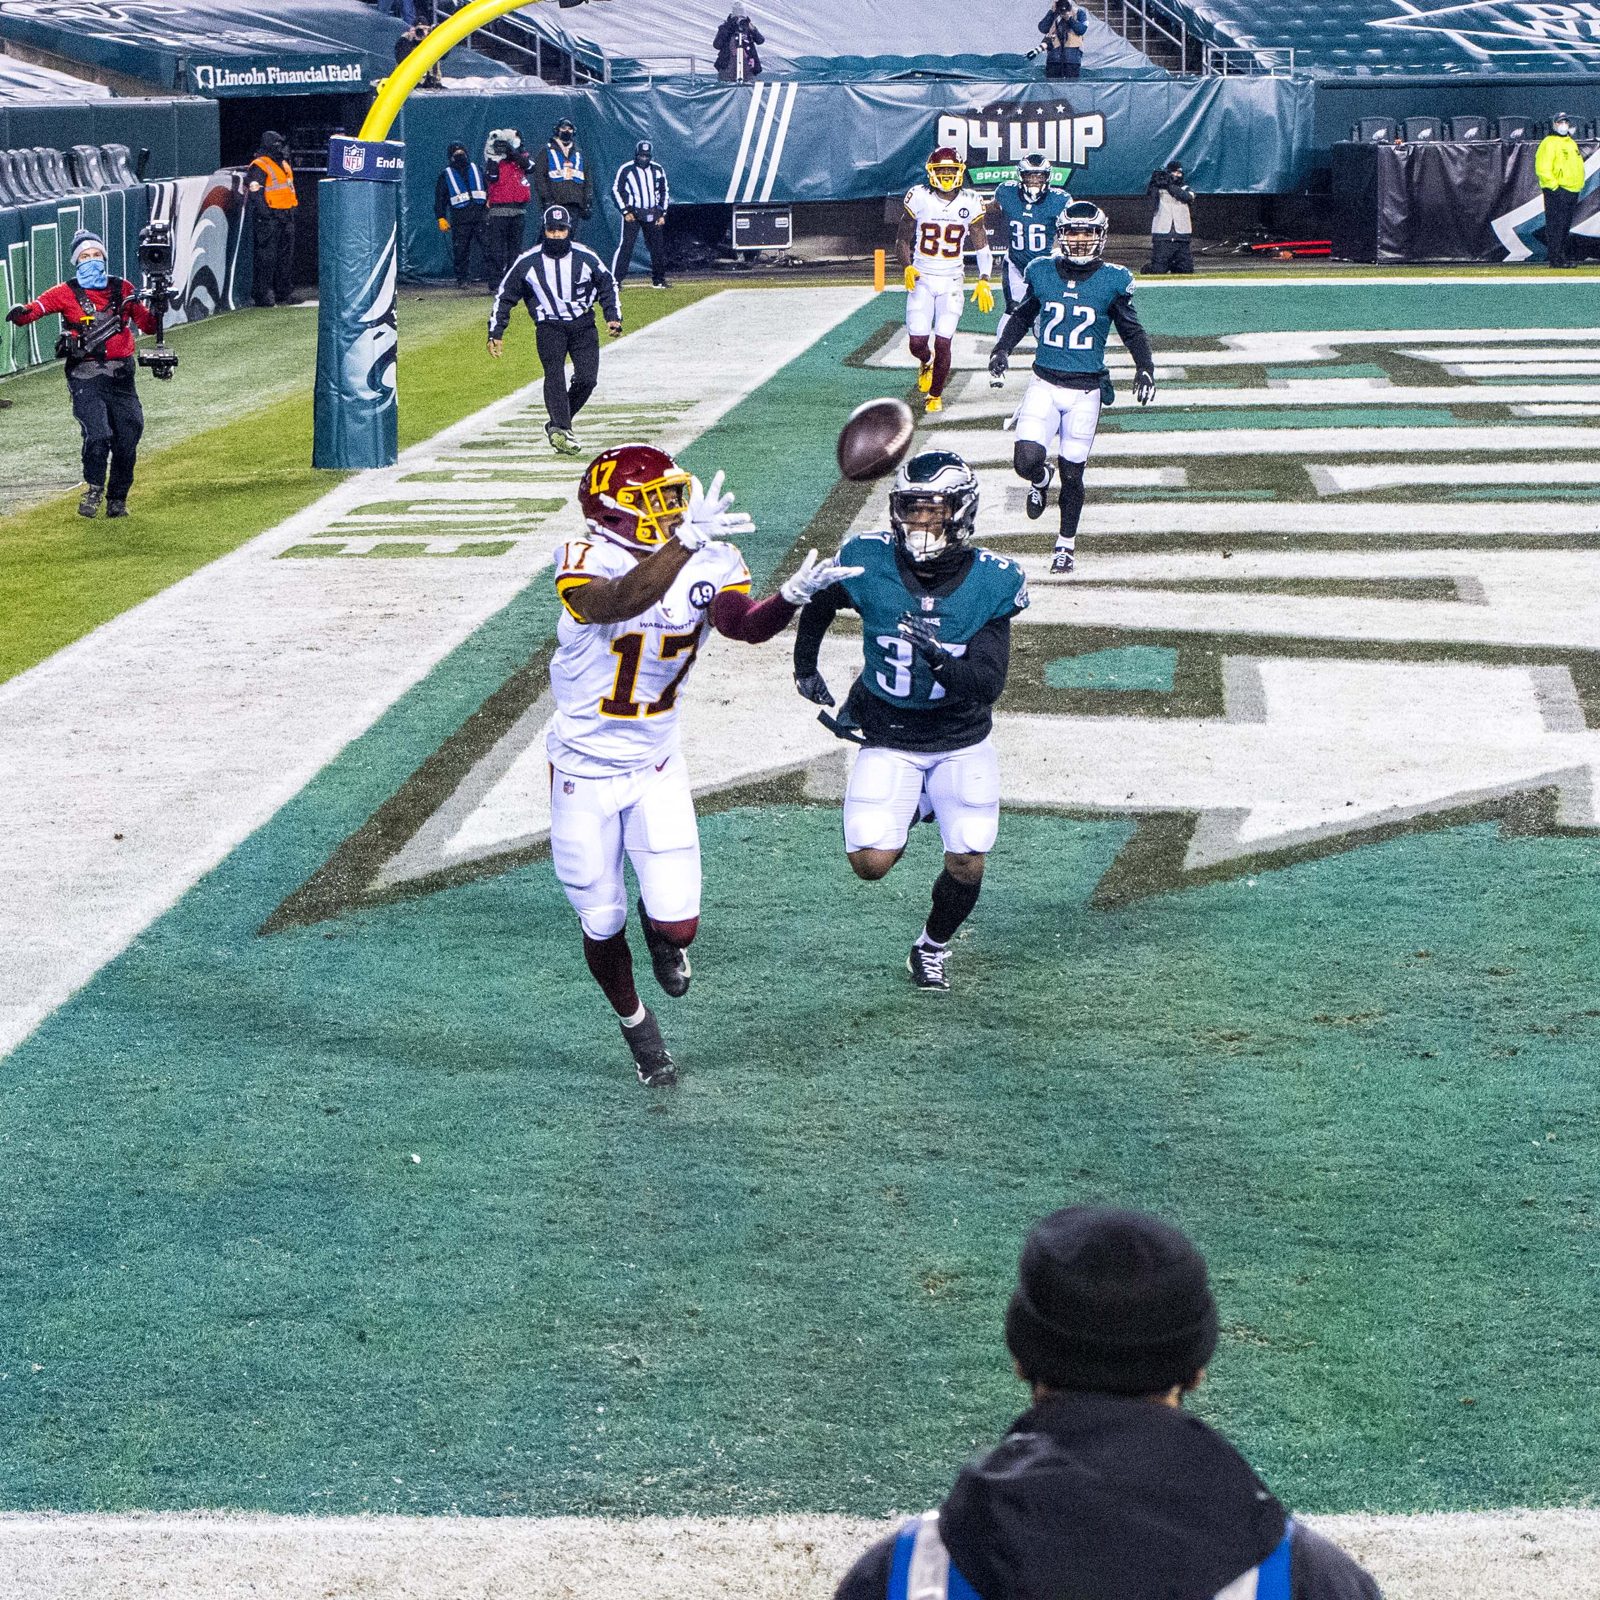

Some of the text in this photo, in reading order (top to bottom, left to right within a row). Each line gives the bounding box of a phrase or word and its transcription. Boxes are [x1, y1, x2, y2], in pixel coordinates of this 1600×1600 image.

[216, 64, 361, 86] Lincoln Financial Field
[938, 114, 1104, 165] 94 WIP
[376, 156, 395, 168] End
[976, 171, 1018, 180] SPORT
[920, 222, 966, 259] 89
[1010, 220, 1047, 252] 36
[1043, 301, 1096, 350] 22
[589, 460, 618, 496] 17
[562, 541, 594, 570] 17
[691, 584, 714, 606] 49
[598, 621, 705, 719] 17
